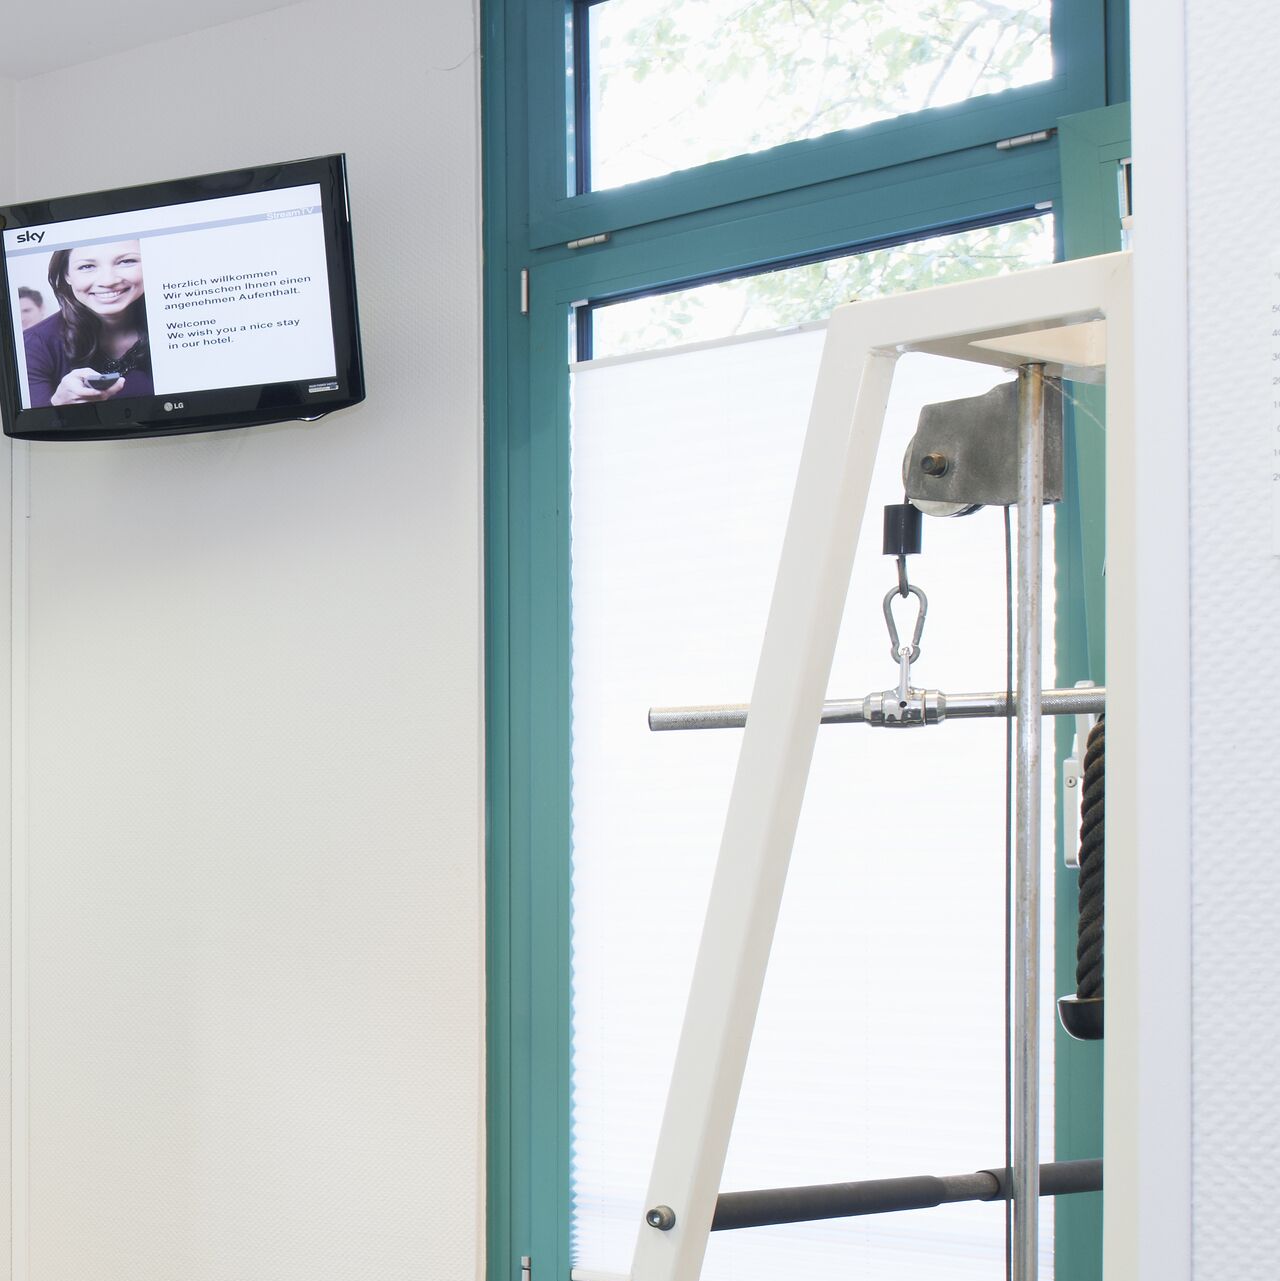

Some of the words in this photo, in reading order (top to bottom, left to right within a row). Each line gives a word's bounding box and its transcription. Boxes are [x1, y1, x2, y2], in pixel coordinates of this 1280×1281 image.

[16, 230, 46, 243] sky
[162, 278, 207, 290] Herzlich
[210, 270, 278, 284] willkommen
[163, 291, 181, 300] Wir
[184, 285, 242, 297] wünschen
[245, 280, 277, 290] Ihnen
[279, 276, 311, 286] einen
[164, 296, 236, 310] angenehmen
[239, 287, 301, 301] Aufenthalt.
[166, 319, 217, 330] Welcome
[167, 332, 184, 340] We
[187, 328, 213, 338] wish
[216, 326, 237, 336] you
[249, 321, 274, 330] nice
[276, 319, 300, 327] stay
[168, 342, 179, 350] in
[181, 340, 200, 348] our
[203, 336, 235, 346] hotel.
[173, 402, 184, 410] LG
